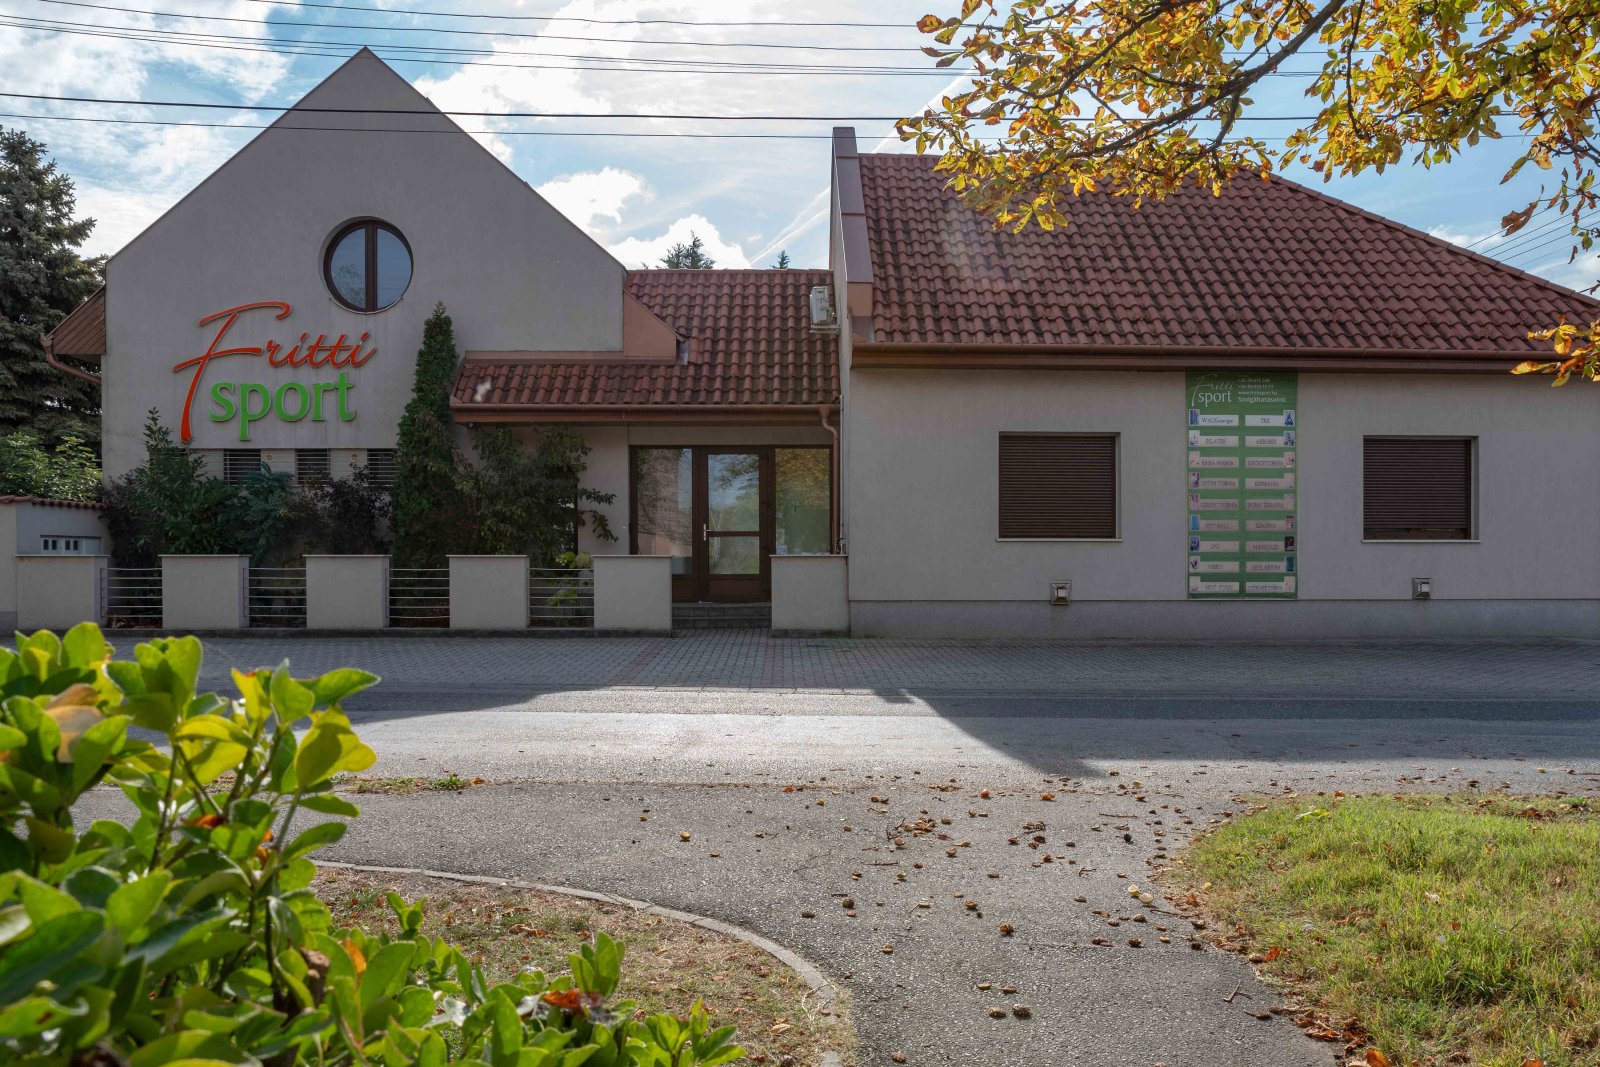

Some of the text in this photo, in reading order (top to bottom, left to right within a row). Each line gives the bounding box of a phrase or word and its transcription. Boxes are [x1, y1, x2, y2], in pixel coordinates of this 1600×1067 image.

[172, 302, 377, 443] Fritti
[1190, 374, 1234, 407] Fritti
[208, 372, 356, 441] sport
[1198, 391, 1232, 407] sport
